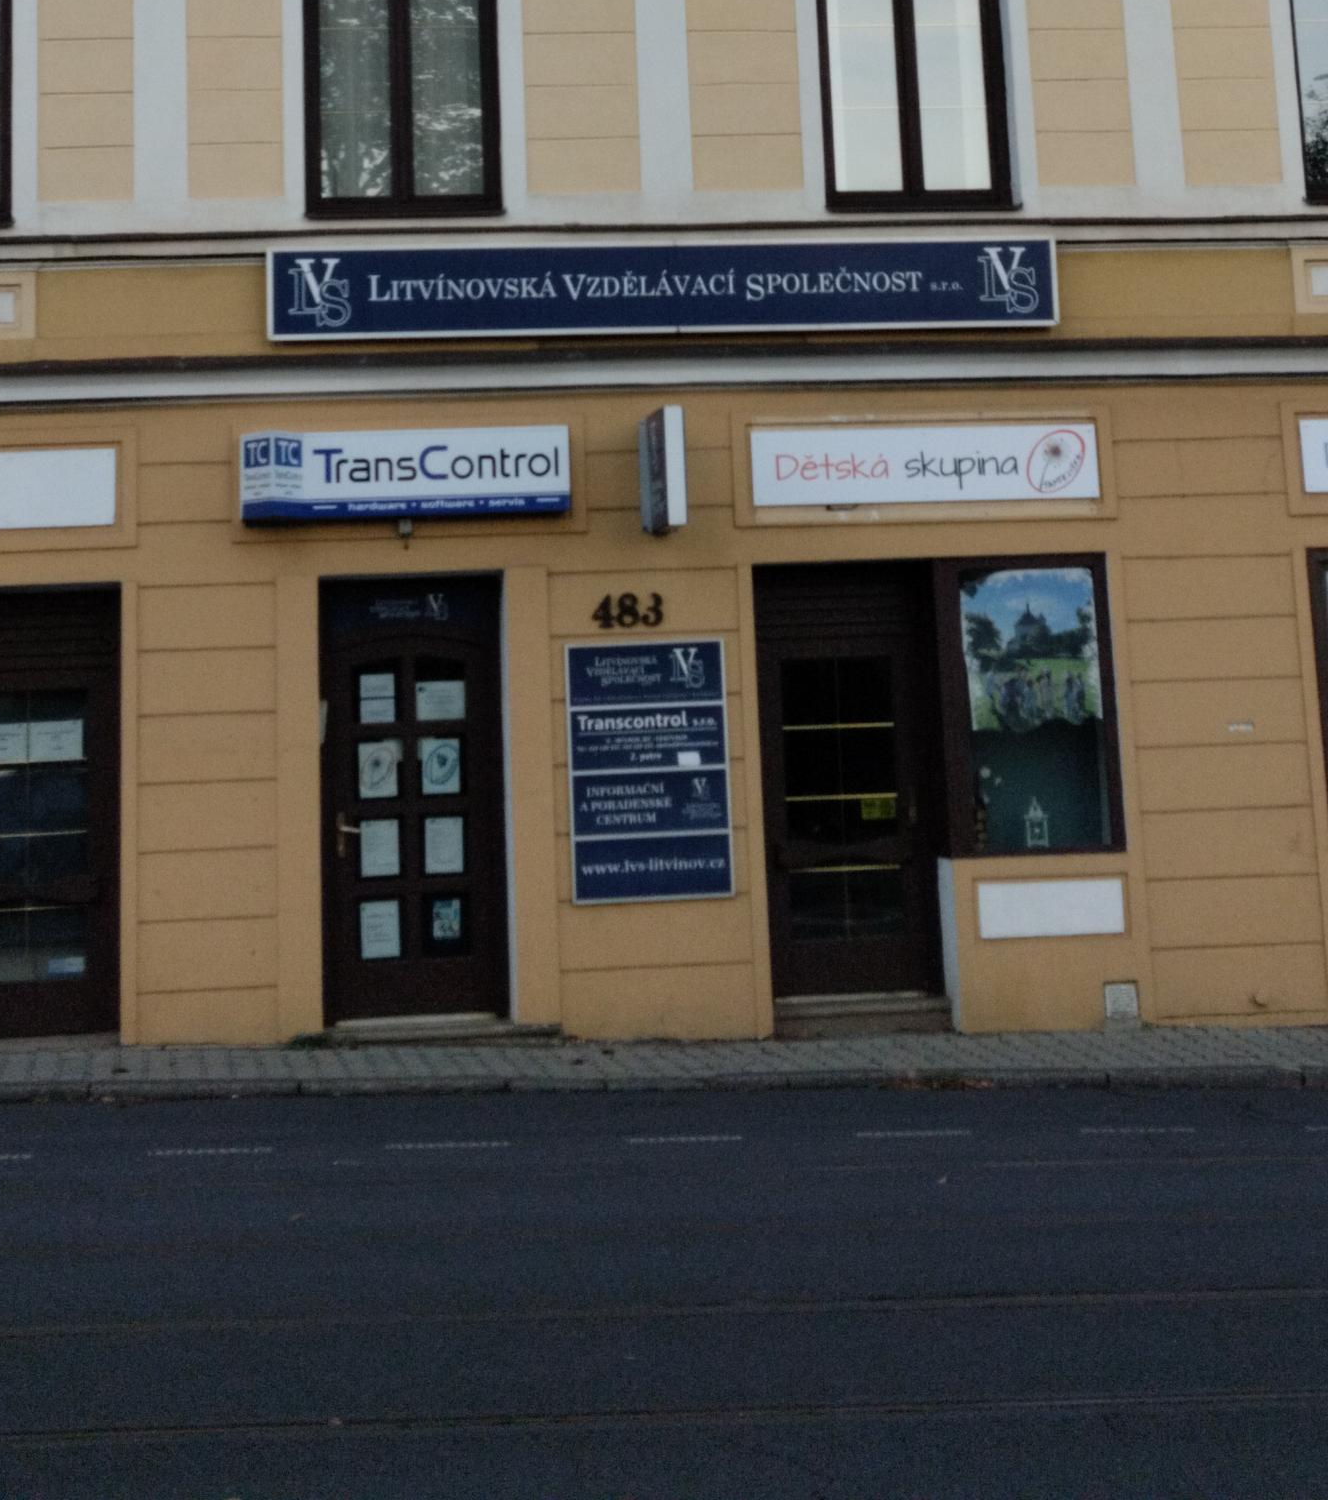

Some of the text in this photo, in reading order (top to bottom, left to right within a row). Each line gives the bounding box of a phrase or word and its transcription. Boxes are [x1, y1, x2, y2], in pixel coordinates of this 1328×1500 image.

[562, 268, 736, 301] VZDĚLÁVACÍ
[745, 267, 922, 301] SPOLEČNOST
[929, 280, 964, 293] s.r.o.
[246, 439, 269, 467] TC
[277, 439, 300, 466] TC
[313, 445, 560, 484] TransControl
[775, 450, 1019, 490] Dětská skupina
[347, 496, 526, 512] hardware software servis
[591, 592, 664, 629] 483
[576, 710, 718, 731] Transcontrol s.r.o.
[595, 812, 657, 826] CENTRUM
